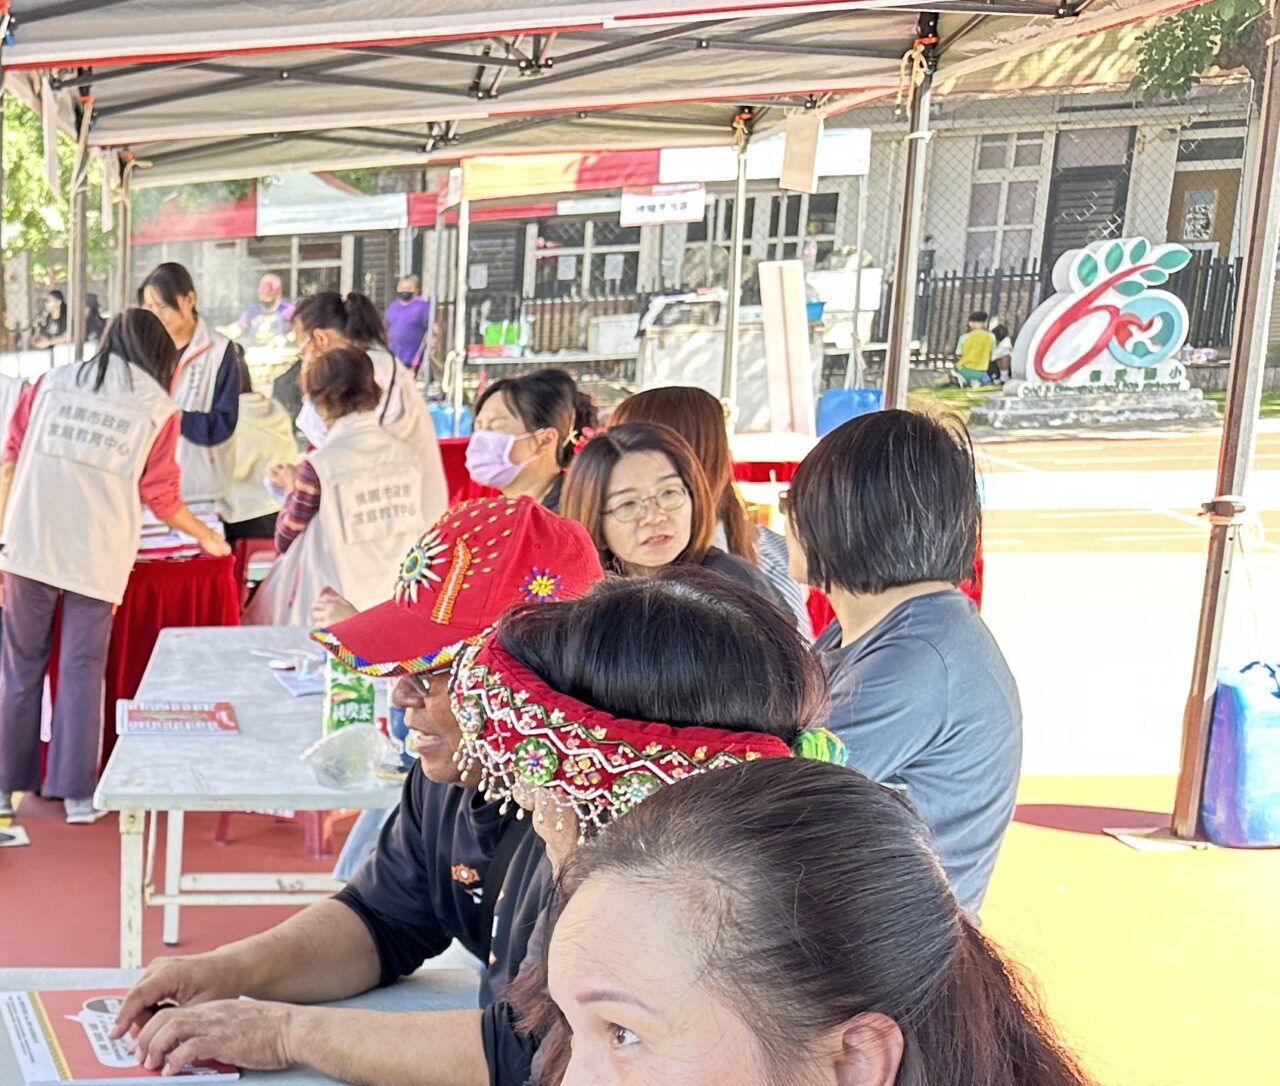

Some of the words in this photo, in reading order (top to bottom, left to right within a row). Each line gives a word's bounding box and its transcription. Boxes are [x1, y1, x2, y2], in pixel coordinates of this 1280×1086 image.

[58, 405, 131, 434] 桃園市政府
[47, 423, 130, 456] 家庭教育中心
